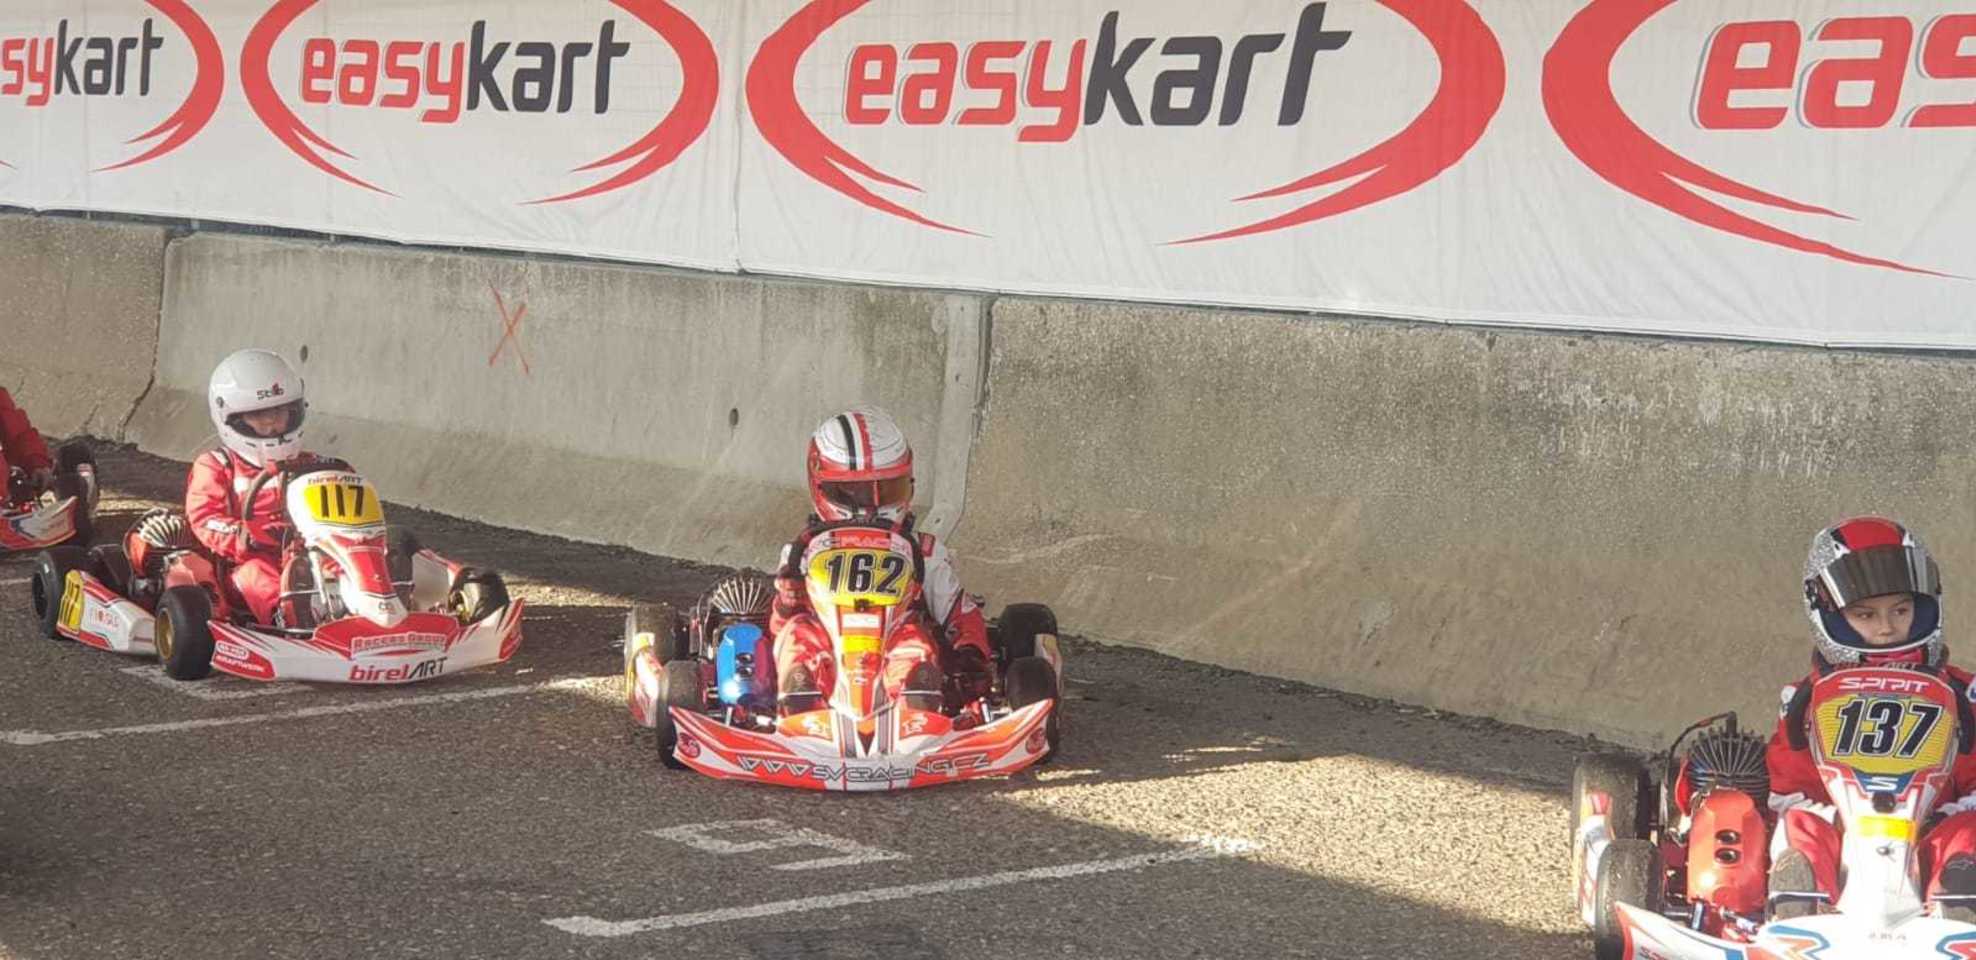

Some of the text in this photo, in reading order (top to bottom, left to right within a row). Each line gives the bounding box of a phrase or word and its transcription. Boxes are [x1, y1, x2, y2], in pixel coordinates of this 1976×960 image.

[300, 19, 631, 123] easykart
[843, 1, 1350, 143] easykart
[320, 484, 364, 518] 117
[825, 551, 907, 596] 162
[349, 656, 448, 681] birelART
[1834, 698, 1943, 760] 137
